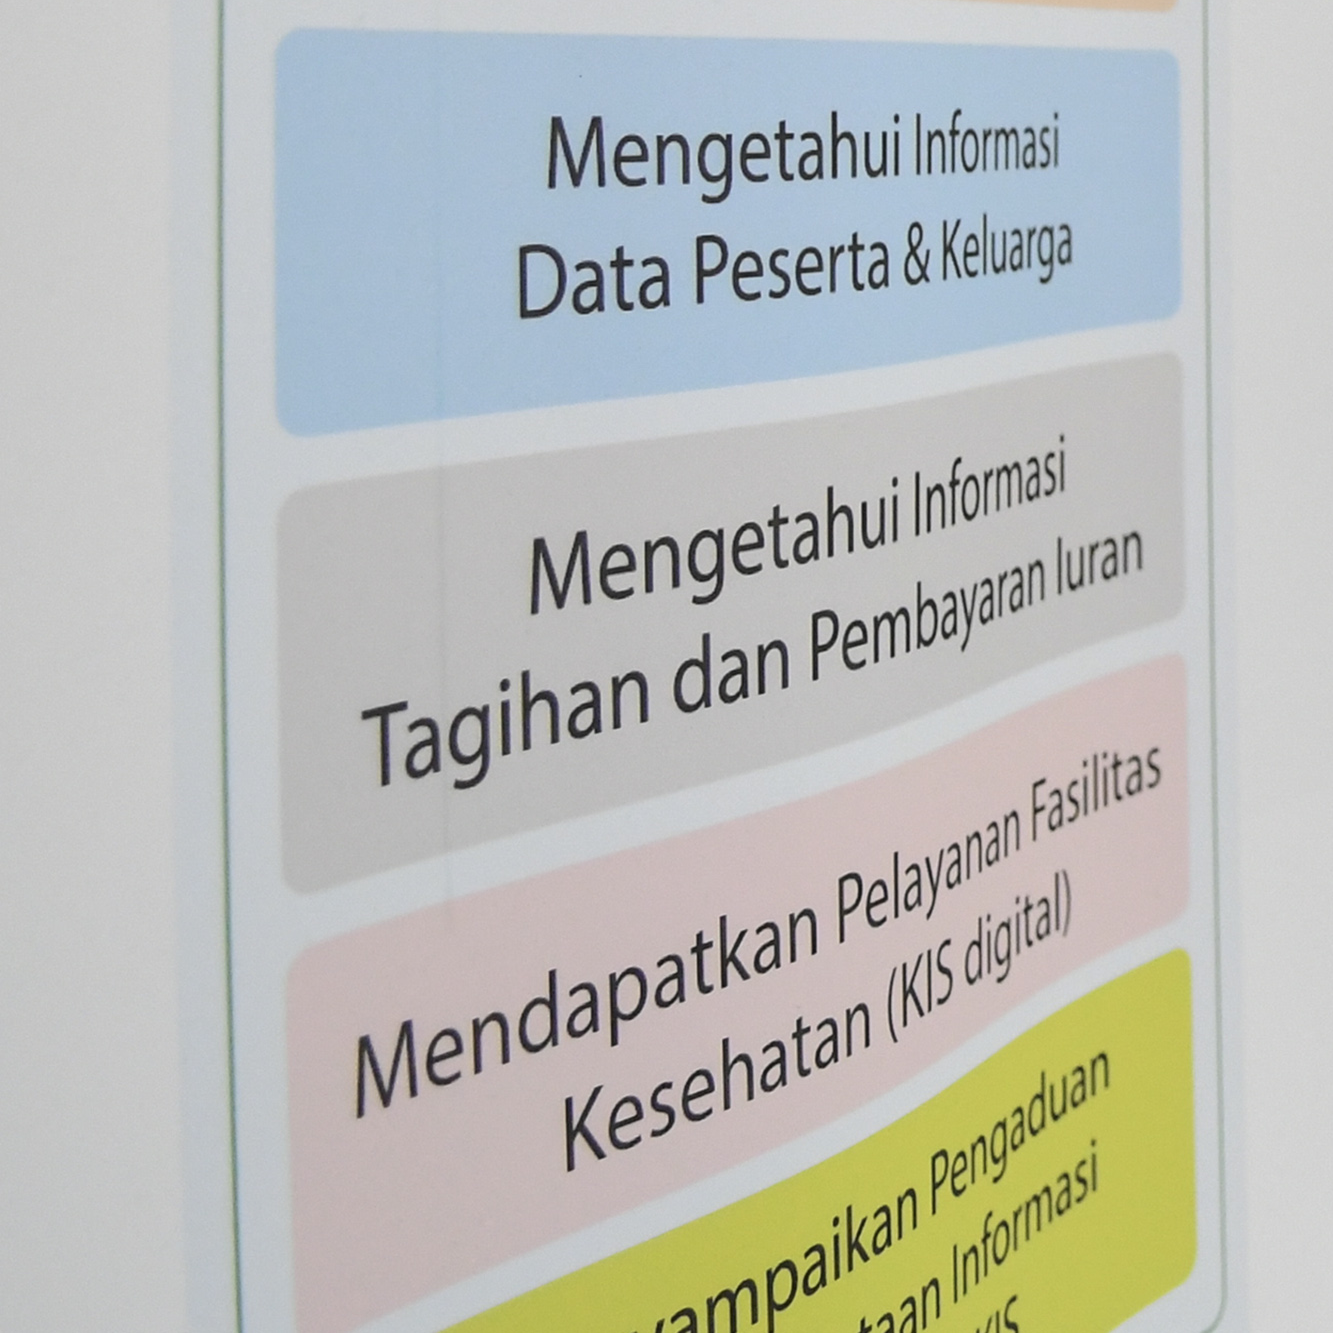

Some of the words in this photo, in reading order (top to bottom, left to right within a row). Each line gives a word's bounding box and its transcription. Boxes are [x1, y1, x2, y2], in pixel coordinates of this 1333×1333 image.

[517, 242, 672, 321] Data
[694, 230, 891, 306] Peserta
[902, 220, 932, 287] &
[941, 212, 1073, 286] Keluarga
[546, 109, 901, 206] Mengetahui
[914, 107, 1060, 177] Informasi
[529, 475, 900, 617] Mengetahui
[913, 434, 1066, 538] Informasi
[359, 668, 650, 792] Tagihan
[672, 631, 790, 715] dan
[810, 558, 1046, 683] Pembayaran
[1056, 530, 1144, 596] Iuran
[355, 907, 819, 1120] Mendapatkan
[837, 809, 1021, 945] Pelayanan
[1031, 746, 1162, 843] Fasilitas
[563, 1001, 872, 1174] Kesehatan
[886, 937, 955, 1045] (KIS
[963, 869, 1072, 987] digital)
[632, 1186, 919, 1333] ampaikan
[929, 1051, 1110, 1217] Pengaduan
[951, 1140, 1098, 1305] Informasi
